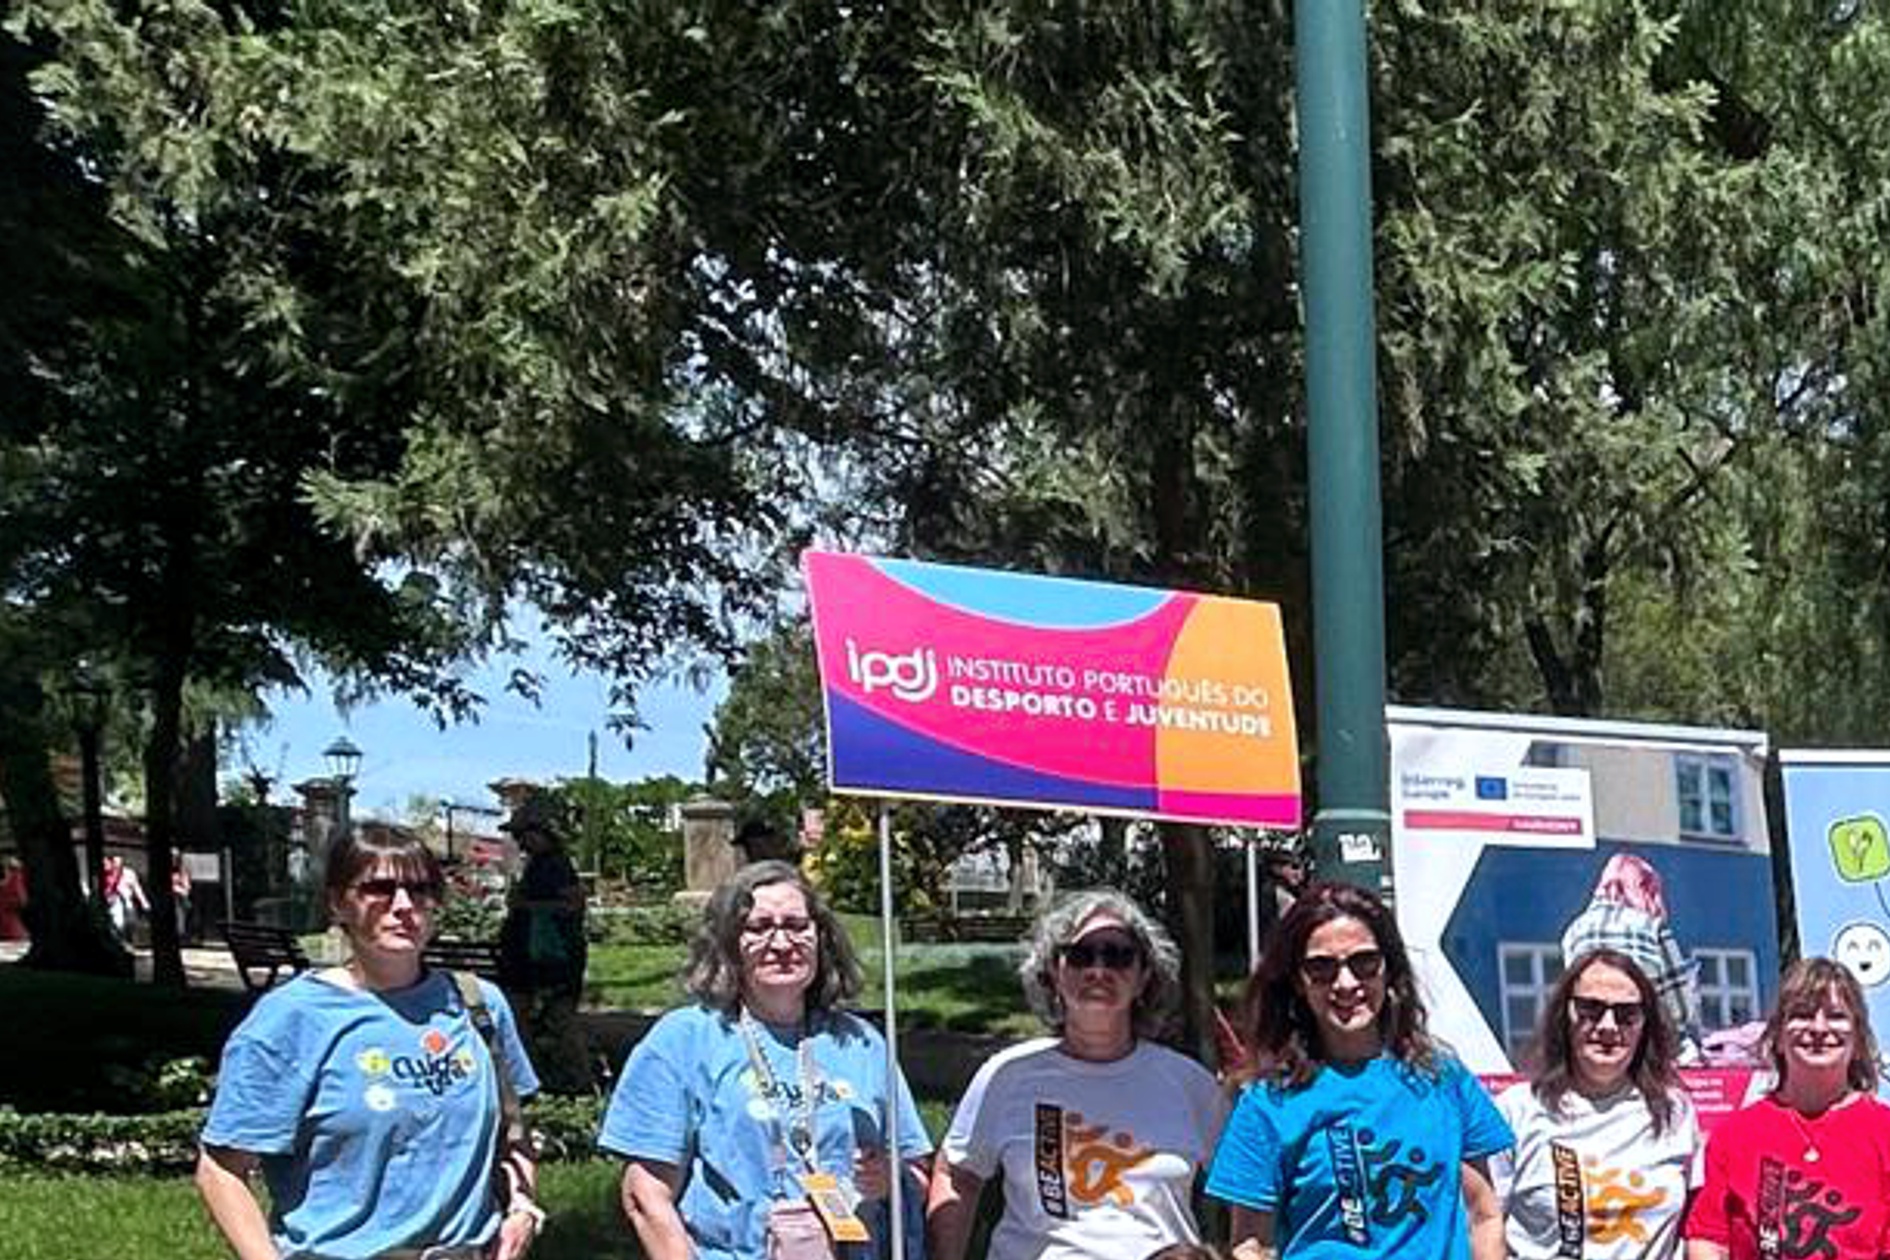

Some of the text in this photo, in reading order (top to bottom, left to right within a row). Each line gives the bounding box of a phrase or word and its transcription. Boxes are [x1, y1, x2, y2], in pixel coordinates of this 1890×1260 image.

[846, 637, 936, 701] ipdj
[948, 655, 1269, 708] INSTITUTO PORTUGUÊS DO
[950, 684, 1272, 738] DESPORTO E JUVENTUDE
